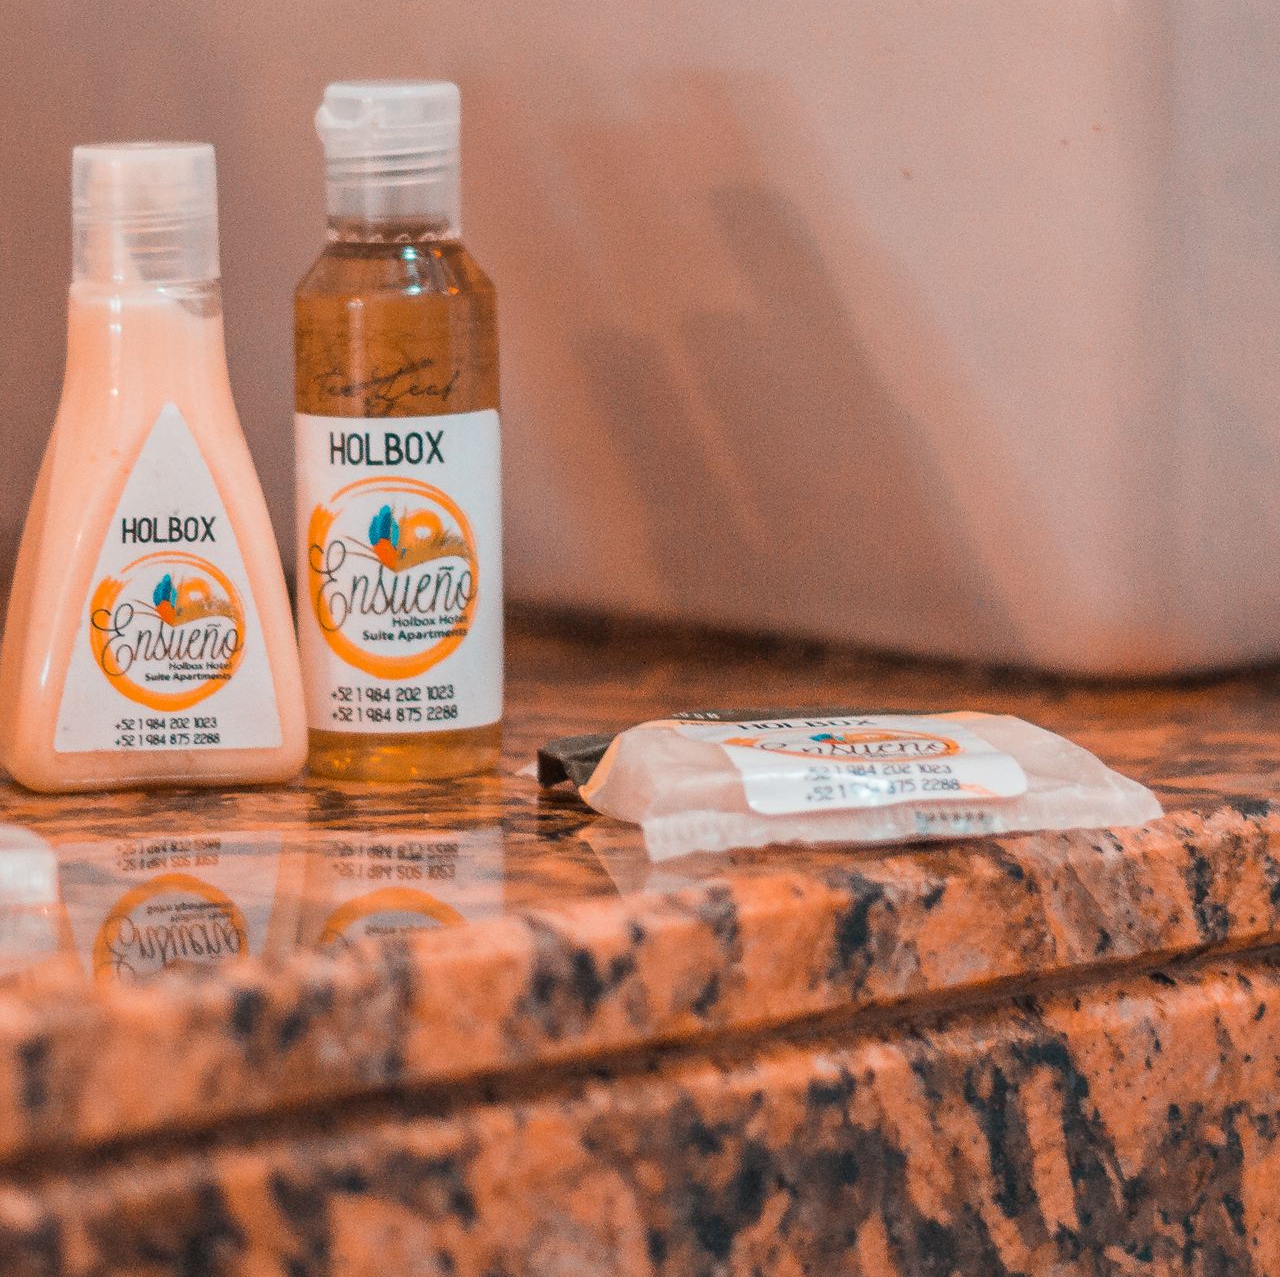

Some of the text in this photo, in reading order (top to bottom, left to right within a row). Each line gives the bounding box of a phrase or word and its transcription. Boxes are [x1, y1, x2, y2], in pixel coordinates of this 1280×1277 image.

[330, 430, 445, 466] HOLBOX
[121, 516, 217, 544] HOLBOX
[308, 539, 477, 632] Ensueño
[392, 615, 436, 627] Holbox
[91, 603, 241, 677] Ensueño
[362, 629, 395, 641] Suite
[144, 672, 171, 682] Suite
[331, 686, 353, 702] +52
[365, 687, 391, 702] 984
[395, 686, 422, 702] 202
[426, 684, 455, 701] 1023
[332, 706, 353, 723] +52
[365, 707, 391, 723] 984
[396, 707, 422, 722] 875
[426, 704, 458, 721] 2288
[115, 718, 135, 731] +52
[145, 718, 166, 730] 984
[169, 717, 190, 729] 202
[193, 716, 218, 729] 1023
[115, 734, 135, 747] +52
[145, 733, 166, 745] 984
[169, 732, 190, 745] 875
[193, 732, 220, 745] 2288
